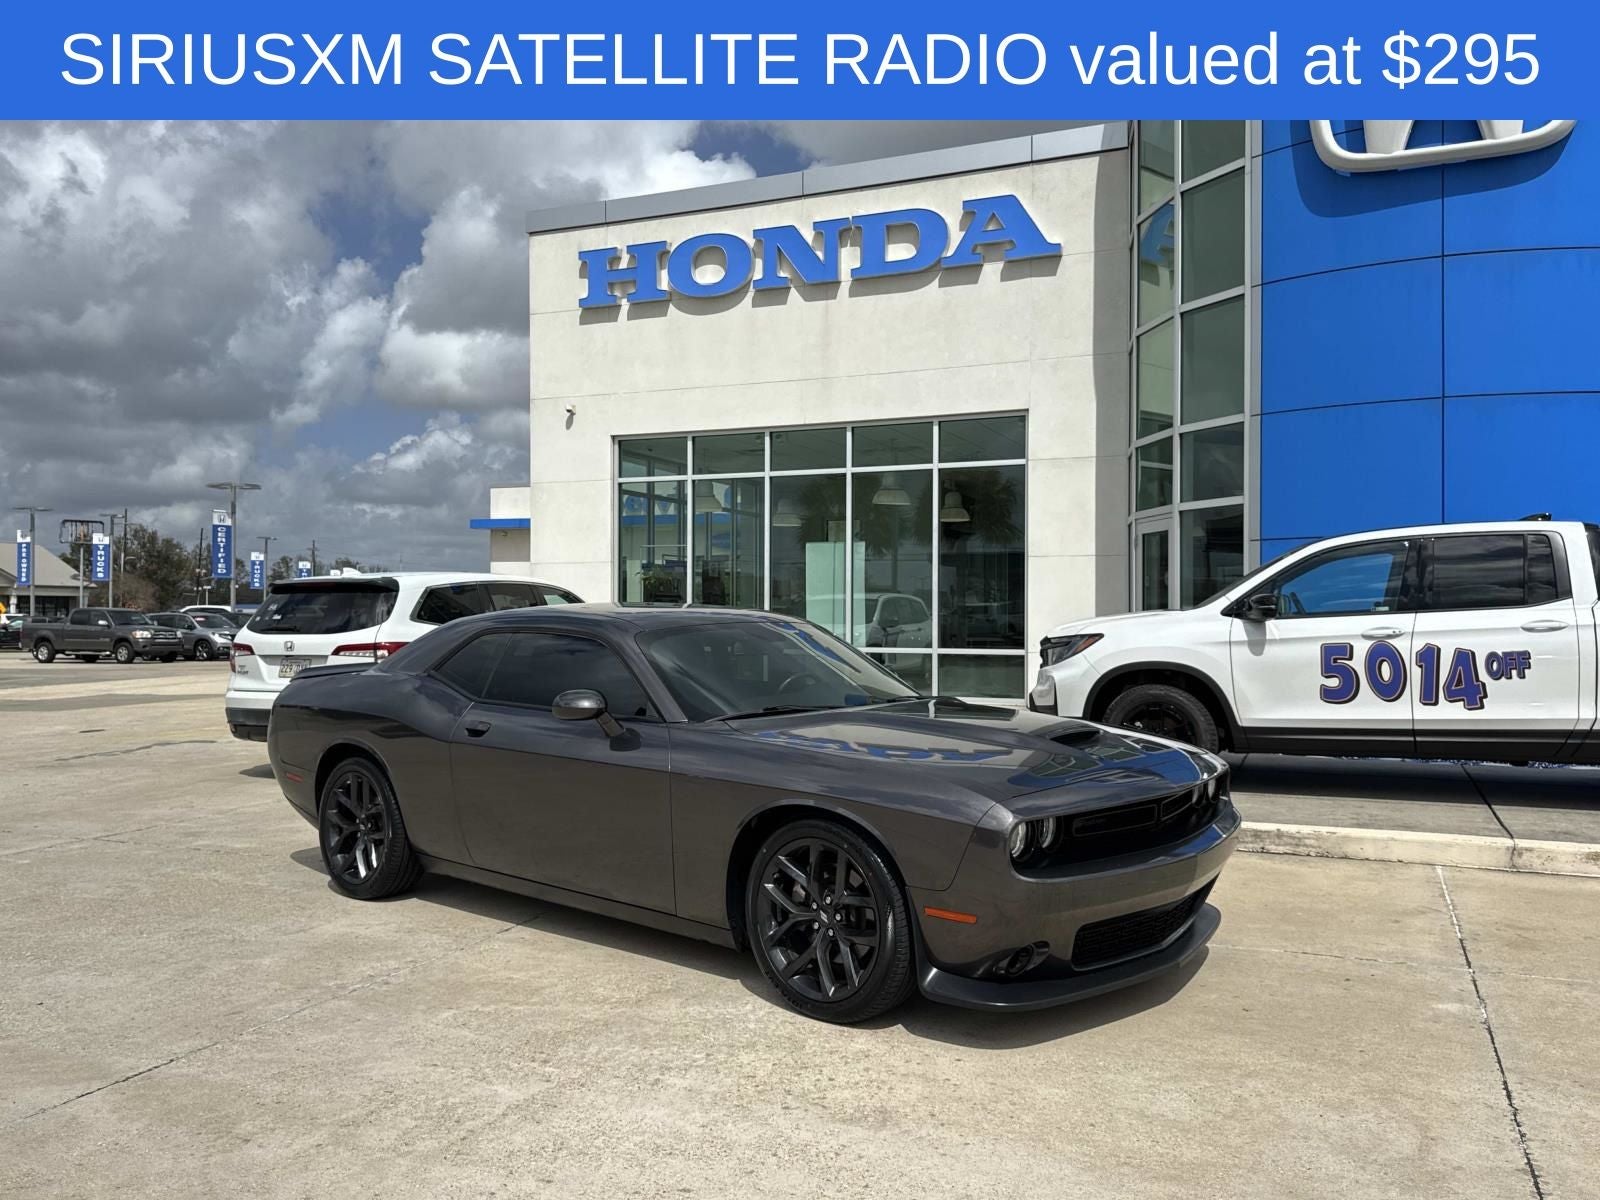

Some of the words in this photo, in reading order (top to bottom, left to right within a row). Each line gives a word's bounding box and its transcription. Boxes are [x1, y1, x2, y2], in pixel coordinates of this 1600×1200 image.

[579, 194, 1062, 309] HONDA
[96, 545, 105, 578] TRUCKS
[217, 527, 226, 574] CERTIFIED
[253, 560, 261, 587] TRUCKS
[1320, 640, 1488, 711] 5014
[1485, 651, 1531, 680] OFF
